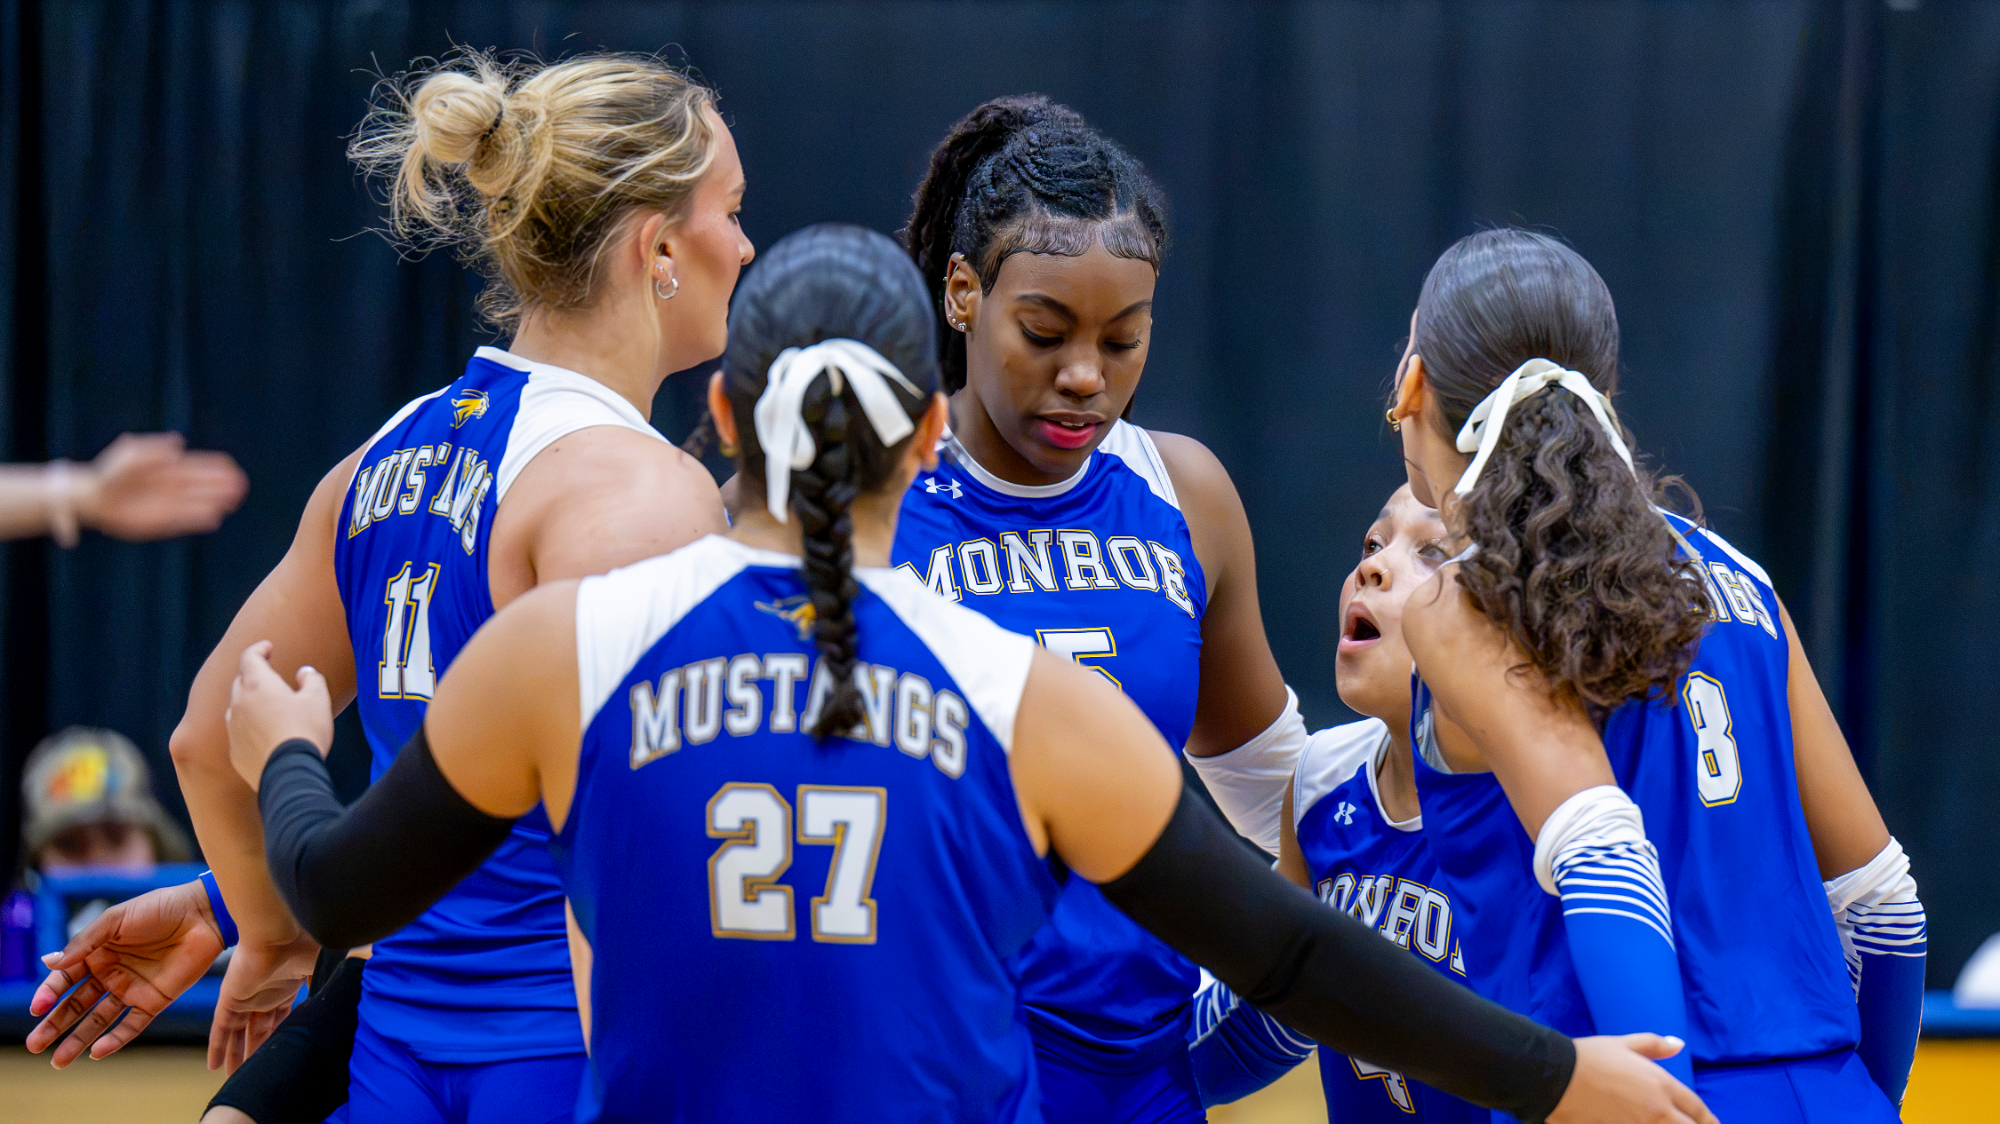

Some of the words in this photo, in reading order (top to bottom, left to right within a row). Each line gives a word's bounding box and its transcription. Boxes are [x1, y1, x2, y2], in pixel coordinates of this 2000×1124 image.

[378, 561, 441, 702] 11
[1683, 671, 1743, 808] 8
[705, 781, 888, 944] 27
